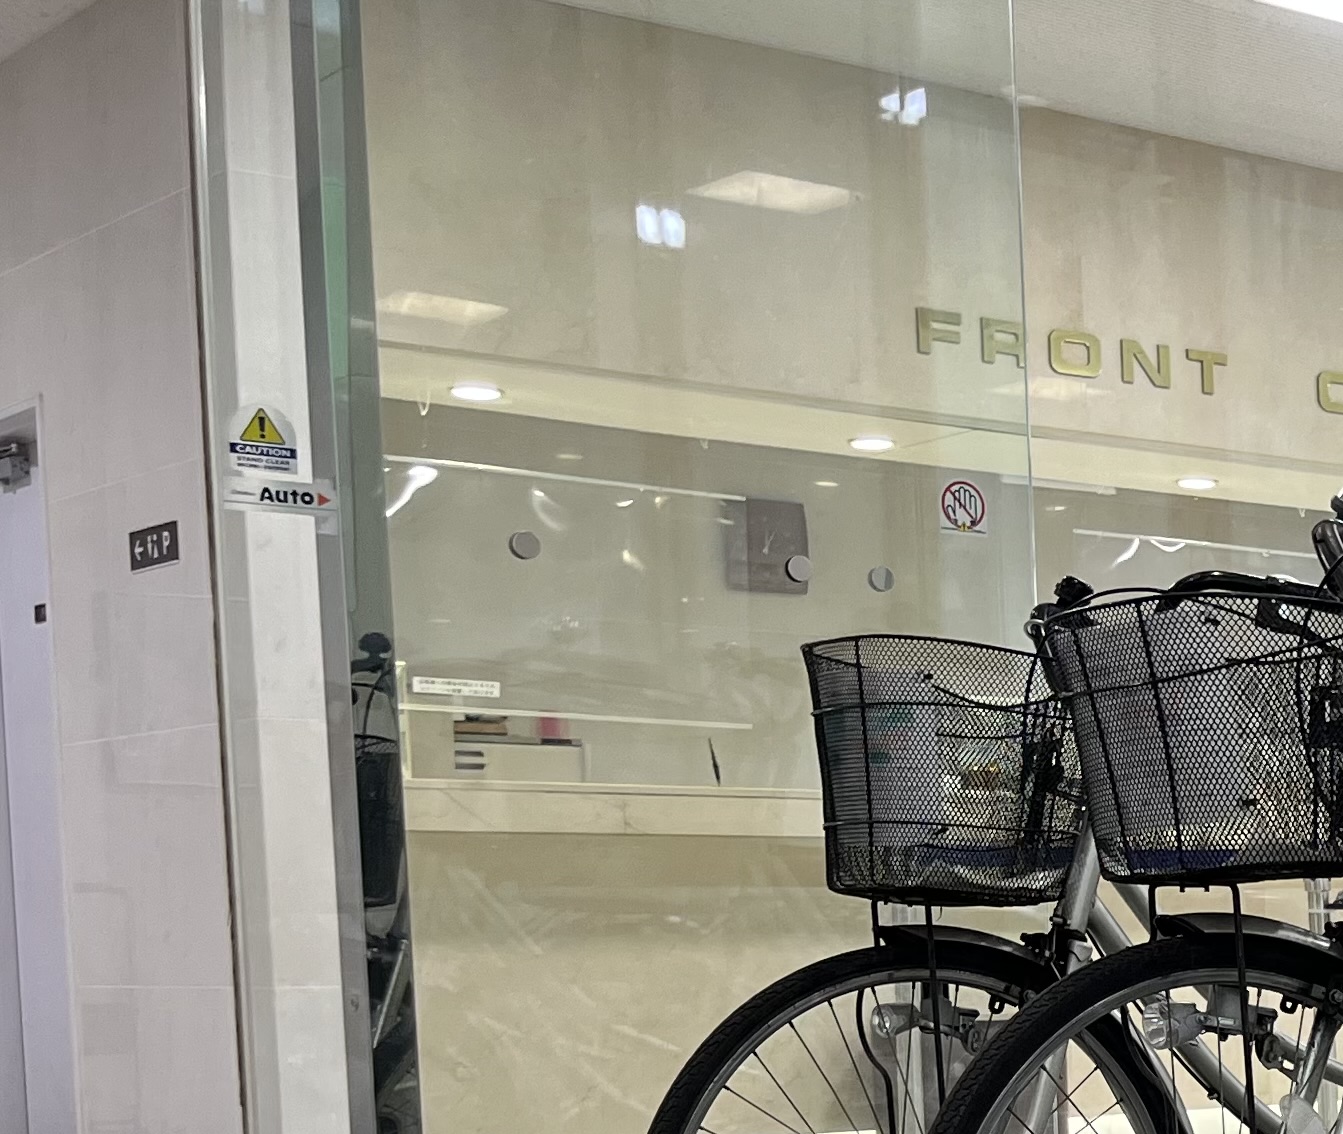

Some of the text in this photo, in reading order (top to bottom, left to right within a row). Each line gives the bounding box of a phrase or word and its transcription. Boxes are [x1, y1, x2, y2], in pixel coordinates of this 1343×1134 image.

[915, 307, 1228, 395] FRONT
[235, 444, 291, 458] CAUTION
[259, 486, 315, 505] Auto
